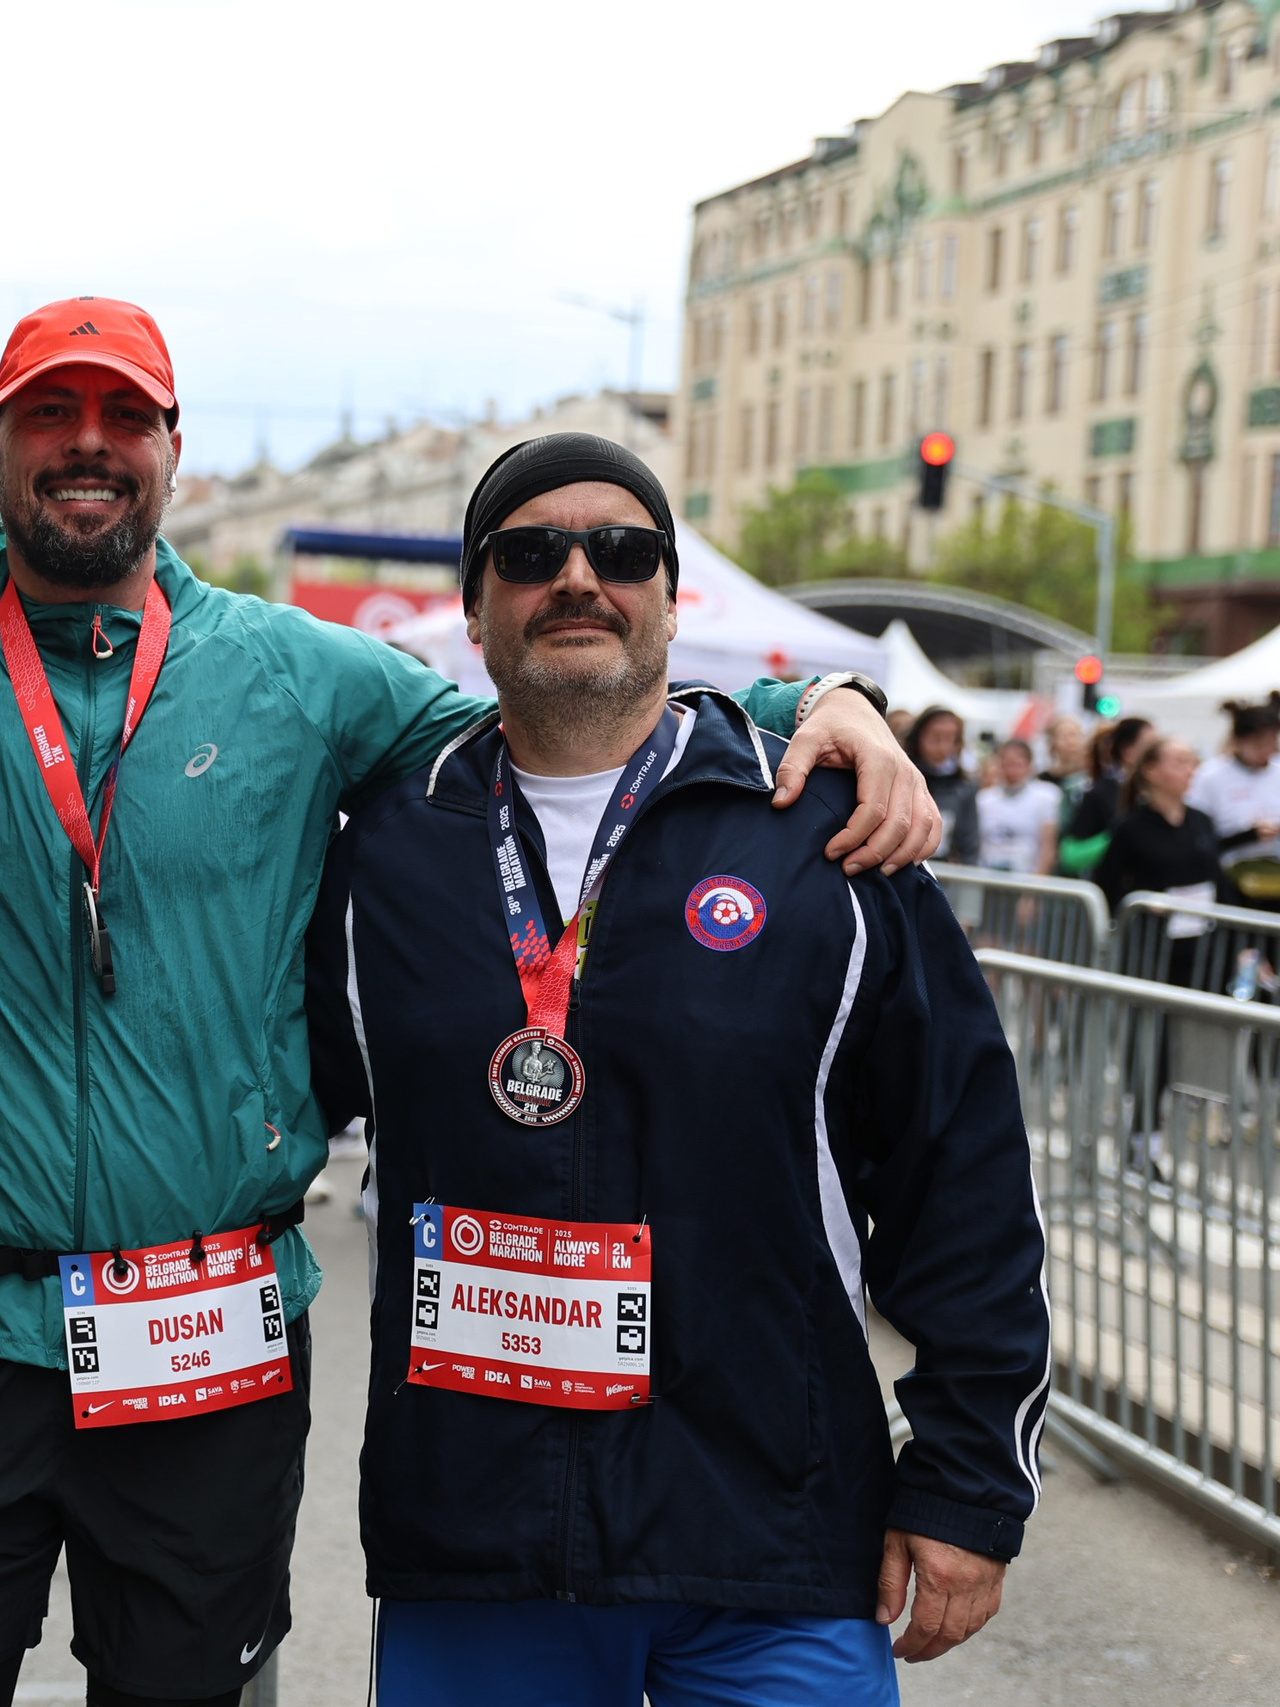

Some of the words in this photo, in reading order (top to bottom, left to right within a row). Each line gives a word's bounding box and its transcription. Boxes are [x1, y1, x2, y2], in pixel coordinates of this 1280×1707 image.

[33, 724, 55, 768] FINISHER
[51, 744, 66, 764] 21K
[629, 750, 657, 794] COMTRADE
[499, 805, 510, 831] 2025
[606, 824, 626, 847] 2025
[497, 844, 515, 893] BELGRADE
[505, 835, 527, 888] MARATHON
[507, 896, 521, 916] 38TH
[506, 1079, 563, 1102] BELGRADE
[523, 1102, 539, 1113] 21K
[422, 1222, 436, 1248] C
[502, 1223, 544, 1235] COMTRADE
[554, 1229, 572, 1238] 2025
[204, 1243, 221, 1252] 2025
[248, 1244, 257, 1256] 21
[489, 1231, 538, 1250] BELGRADE
[554, 1239, 600, 1255] ALWAYS
[612, 1242, 625, 1255] 21
[158, 1248, 191, 1261] COMTRAD
[206, 1247, 244, 1266] ALWAYS
[249, 1254, 262, 1268] KM
[489, 1244, 543, 1263] MARATHON
[553, 1252, 586, 1268] MORE
[612, 1255, 632, 1269] KM
[145, 1258, 192, 1278] BELGRADE
[207, 1262, 236, 1278] MORE
[71, 1272, 85, 1296] C
[146, 1269, 199, 1290] MARATHON
[451, 1283, 603, 1329] ALEKSANDAR
[148, 1307, 224, 1345] DUSAN
[501, 1332, 542, 1355] 5353
[170, 1349, 211, 1373] 5246
[452, 1364, 475, 1373] POWER
[484, 1370, 511, 1385] iDEA
[534, 1379, 552, 1388] SAVA
[207, 1386, 223, 1395] SAVA
[606, 1383, 635, 1397] Wellness
[122, 1397, 148, 1406] POWER
[158, 1393, 187, 1407] iDEA
